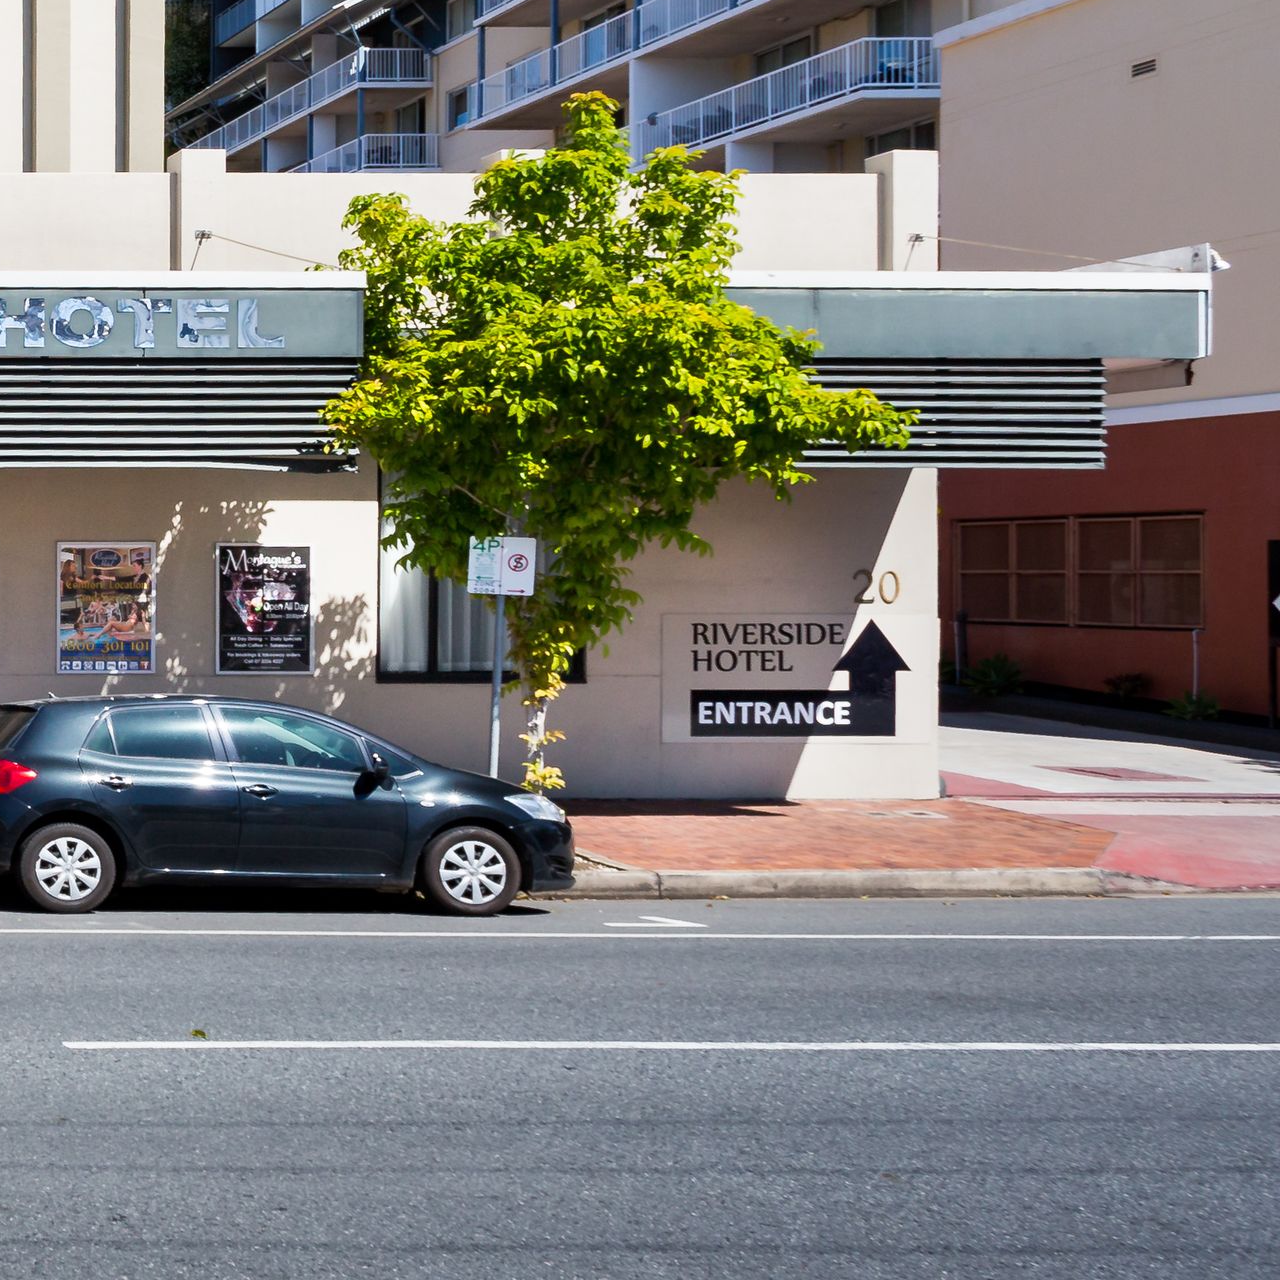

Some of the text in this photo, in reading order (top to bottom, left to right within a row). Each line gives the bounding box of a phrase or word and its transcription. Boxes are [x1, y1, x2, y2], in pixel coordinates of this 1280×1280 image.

[221, 548, 302, 575] Montague's
[852, 569, 901, 604] 20
[263, 602, 309, 613] Open All Day
[691, 623, 845, 645] RIVERSIDE
[100, 641, 125, 654] 301
[130, 640, 149, 652] 101
[691, 650, 793, 672] HOTEL
[698, 701, 851, 725] ENTRANCE
